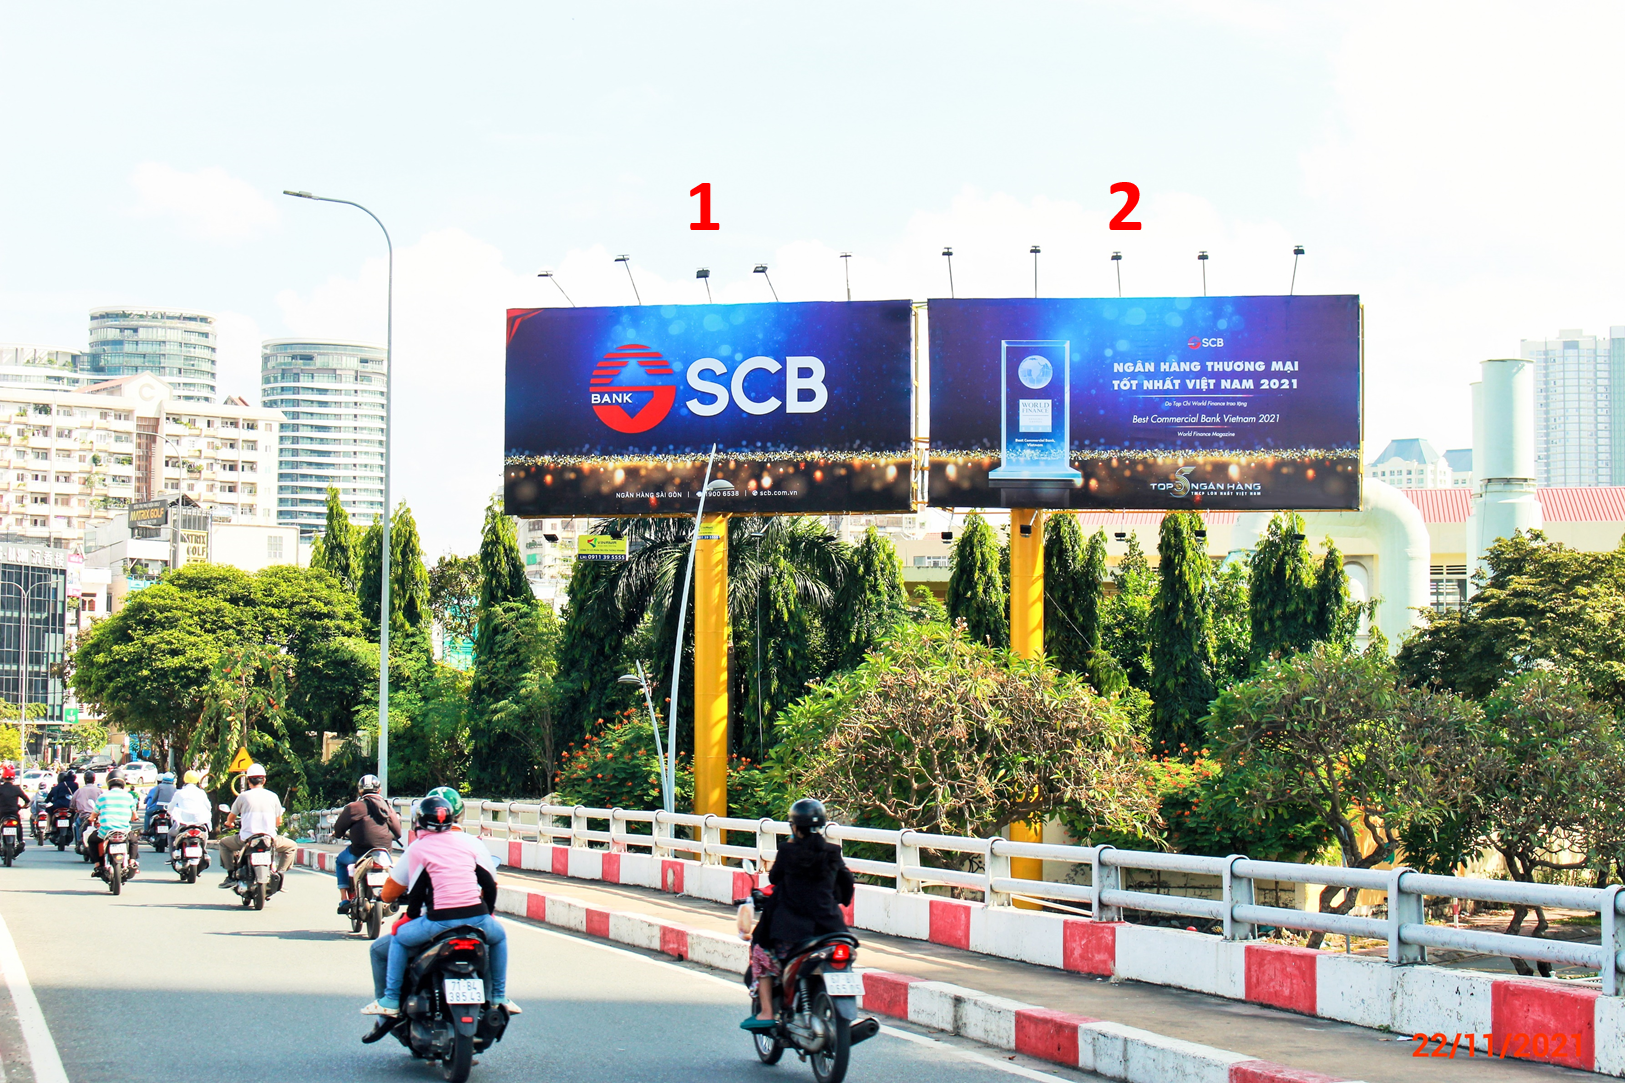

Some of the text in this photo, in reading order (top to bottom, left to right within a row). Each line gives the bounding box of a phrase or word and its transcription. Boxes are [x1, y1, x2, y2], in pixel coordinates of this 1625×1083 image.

[1202, 338, 1224, 348] SCB
[1113, 359, 1299, 374] NGÂN HÀNG THƯƠNG MẠI
[685, 355, 829, 417] SCB
[1112, 376, 1298, 391] TỐT NHẤT VIỆT NAM 2021
[591, 393, 633, 404] BANK
[1132, 413, 1280, 424] Best Commercial Bank Vietnam 2021
[1149, 466, 1262, 498] TOP 5 NGÂN HÀNG
[615, 490, 683, 499] NGÂN HÀNG SÀI GÒN
[130, 507, 165, 522] MATRIX GOLF
